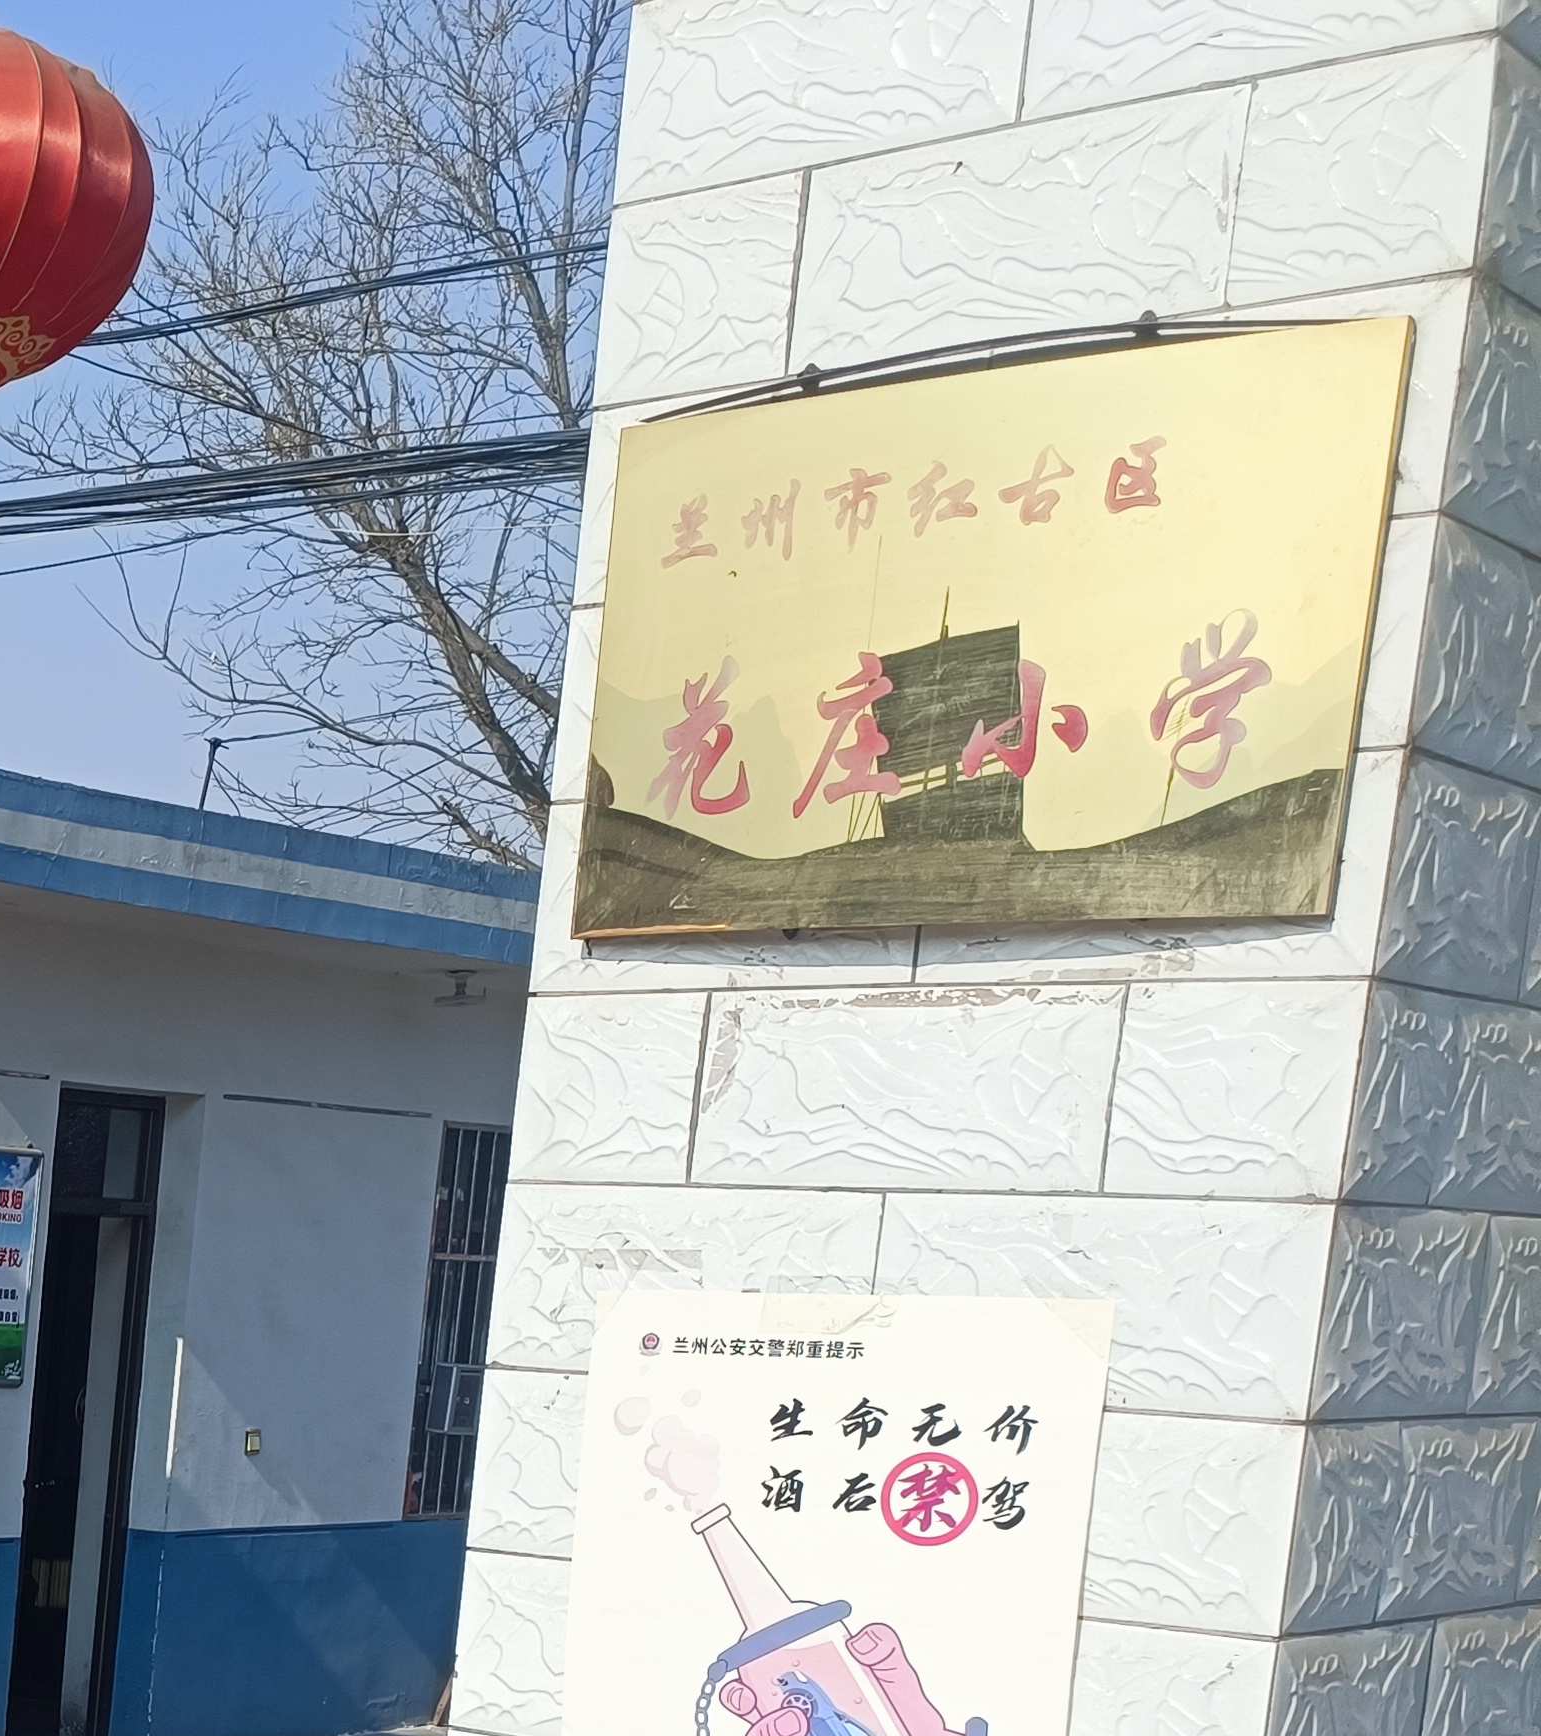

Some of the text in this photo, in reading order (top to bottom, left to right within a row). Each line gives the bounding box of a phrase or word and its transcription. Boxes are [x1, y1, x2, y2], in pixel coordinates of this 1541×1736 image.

[660, 434, 1168, 570] 兰州市红古区
[645, 607, 1273, 820] 花庄小学
[672, 1336, 865, 1360] 兰州公安交警郑重提示
[769, 1396, 1039, 1456] 生命无价
[760, 1464, 1030, 1533] 酒后禁驾
